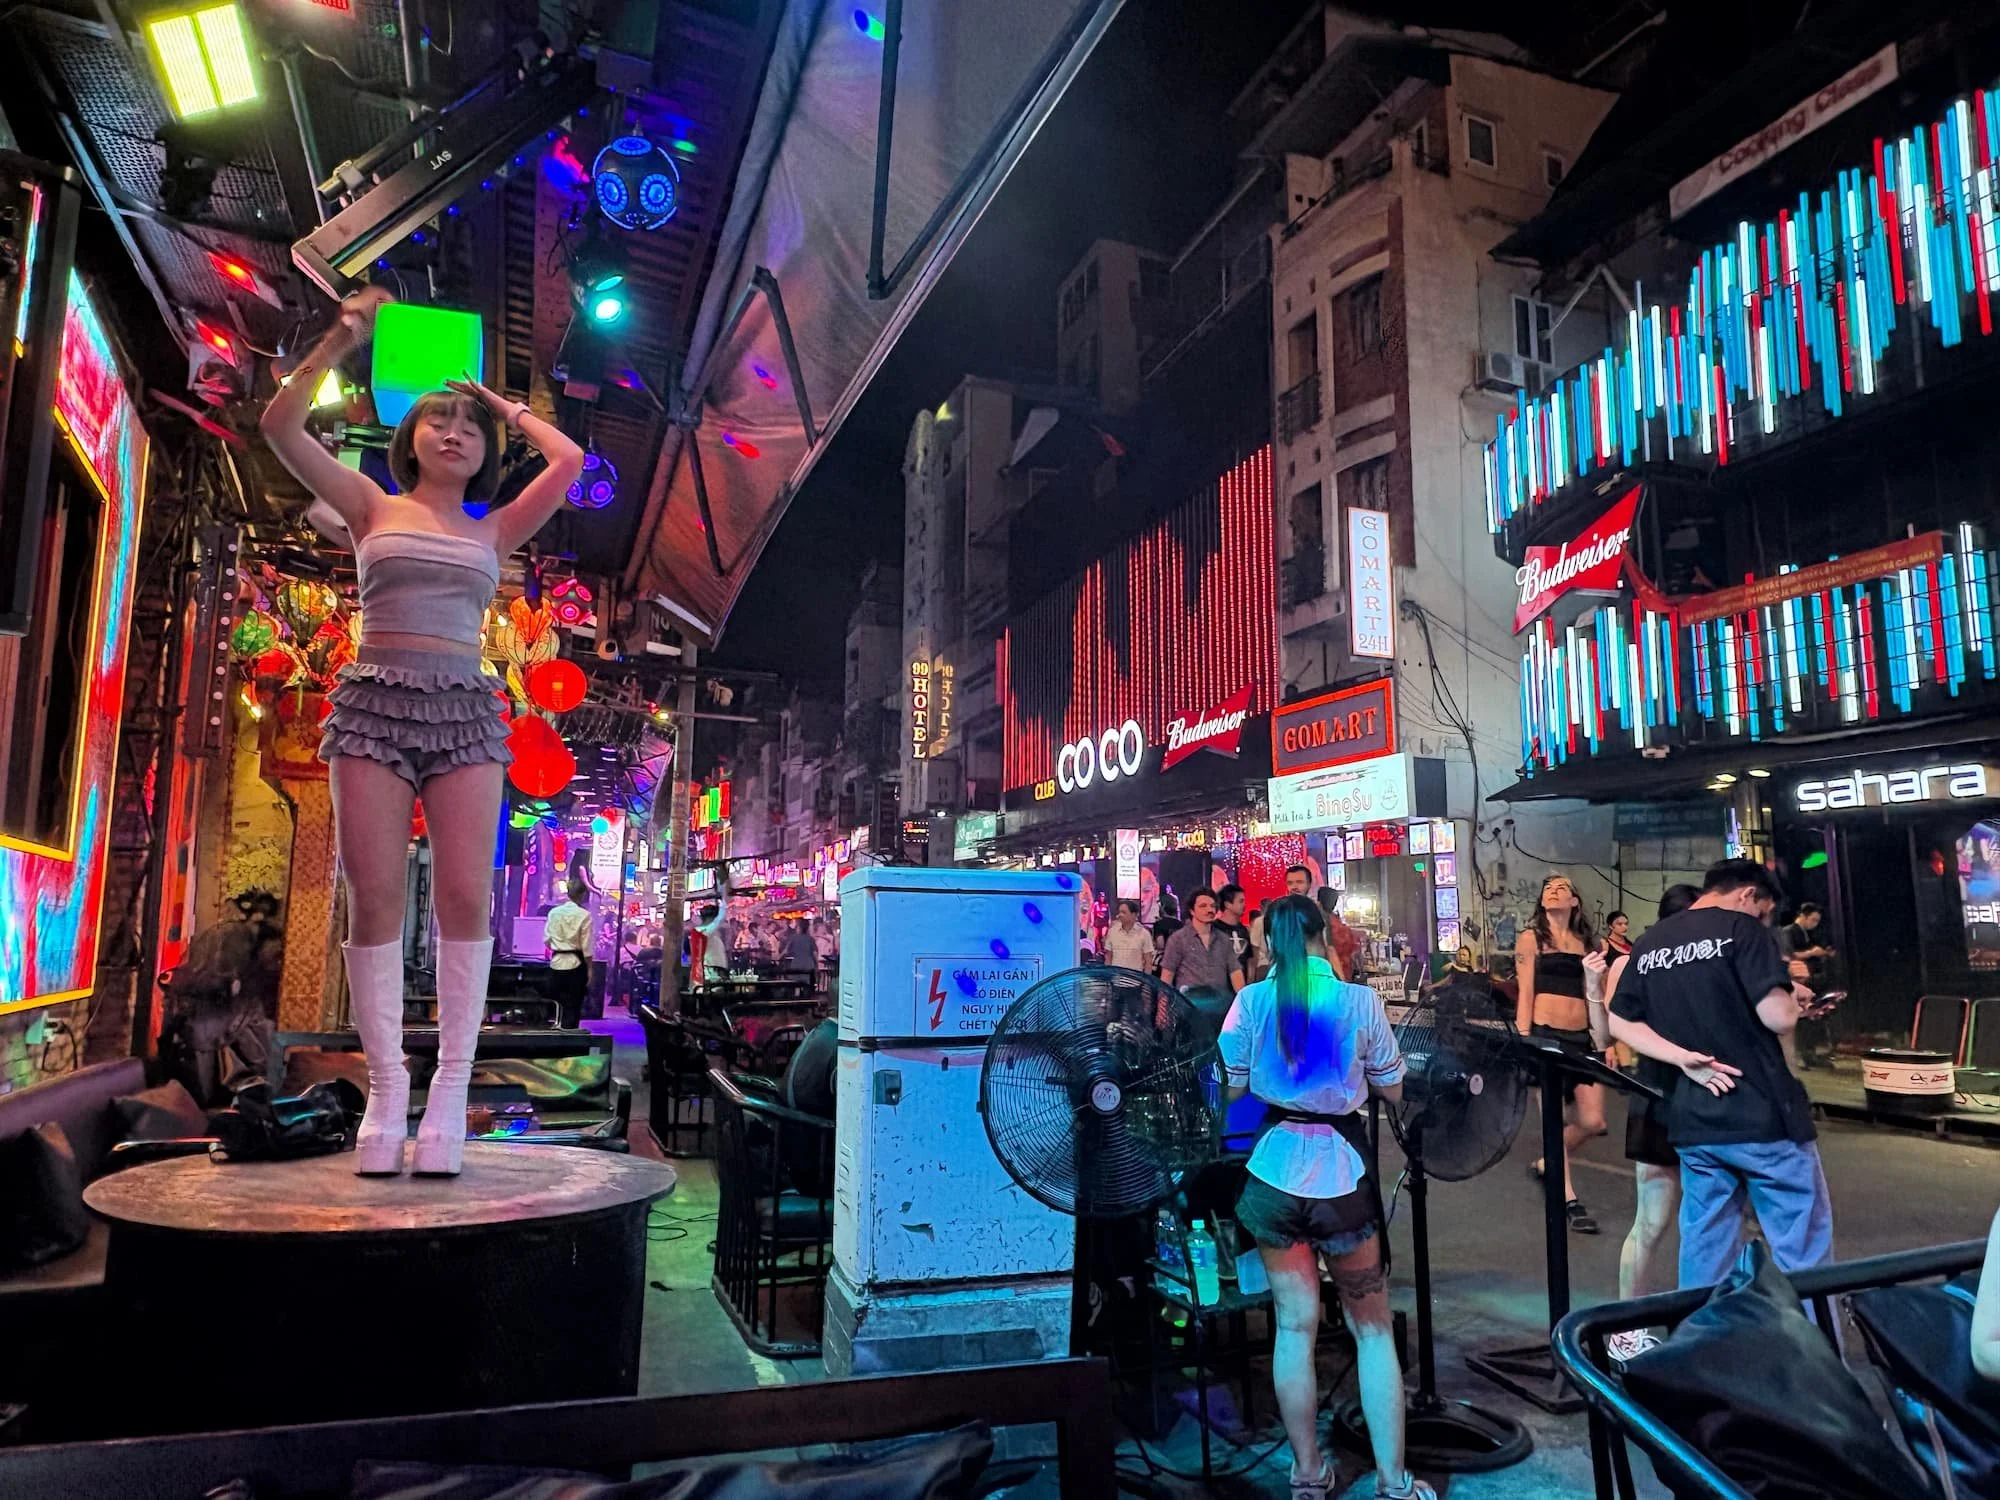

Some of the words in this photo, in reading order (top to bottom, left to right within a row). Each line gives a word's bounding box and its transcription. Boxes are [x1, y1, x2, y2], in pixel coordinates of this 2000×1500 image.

[1718, 107, 1808, 175] Cooking
[1360, 515, 1383, 631] GOMART
[1515, 527, 1630, 605] Budweiser
[1358, 632, 1389, 652] 24H
[912, 677, 929, 759] HOTEL
[1167, 709, 1246, 750] Budweiser
[1283, 706, 1378, 753] GOMART
[1035, 779, 1056, 800] CLUB
[1315, 788, 1372, 821] BingSu
[1797, 763, 1987, 811] sahara
[1637, 938, 1733, 975] PARADOX
[962, 1004, 993, 1014] NGUY
